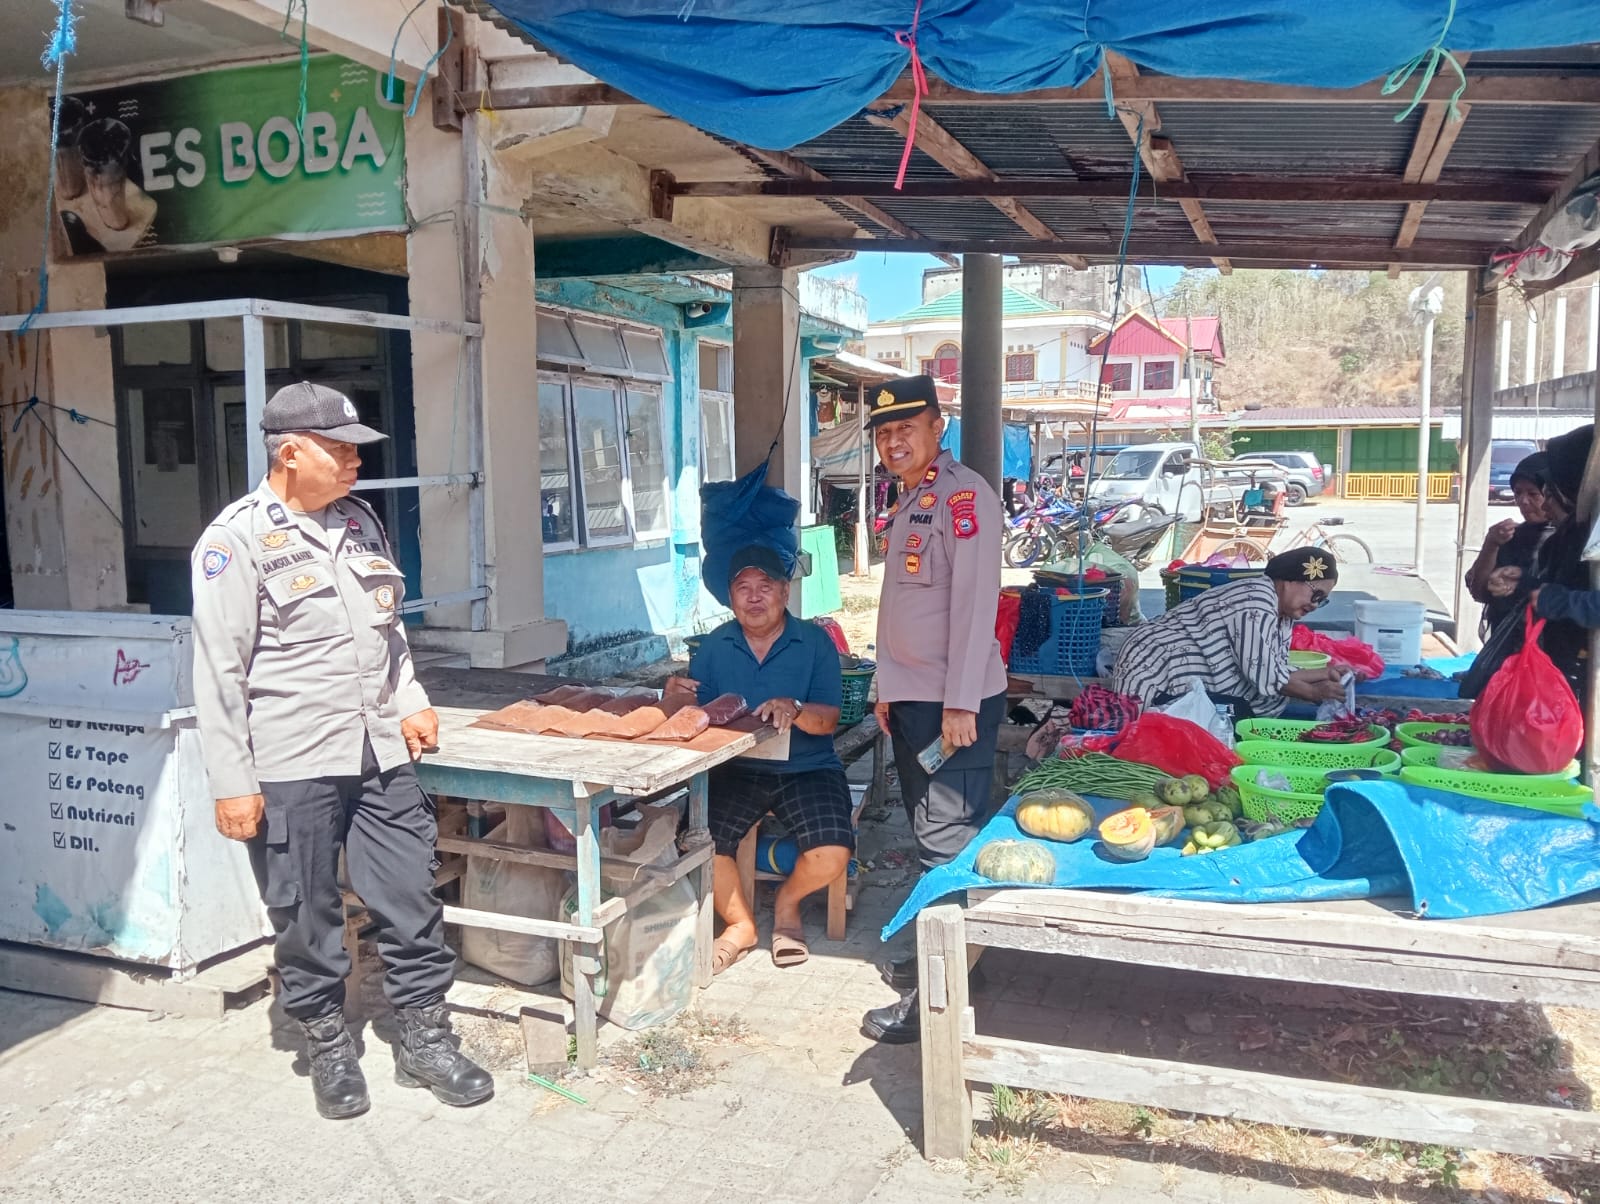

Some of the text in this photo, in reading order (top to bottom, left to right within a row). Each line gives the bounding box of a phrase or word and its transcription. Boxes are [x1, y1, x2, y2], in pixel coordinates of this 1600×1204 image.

[139, 106, 386, 191] ES BOBA
[909, 513, 933, 525] POLRI
[345, 542, 381, 554] POLRI
[65, 744, 129, 765] Es Tape
[66, 775, 144, 800] Es Poteng
[67, 805, 135, 826] Nutrisari
[70, 835, 99, 852] Dll.
